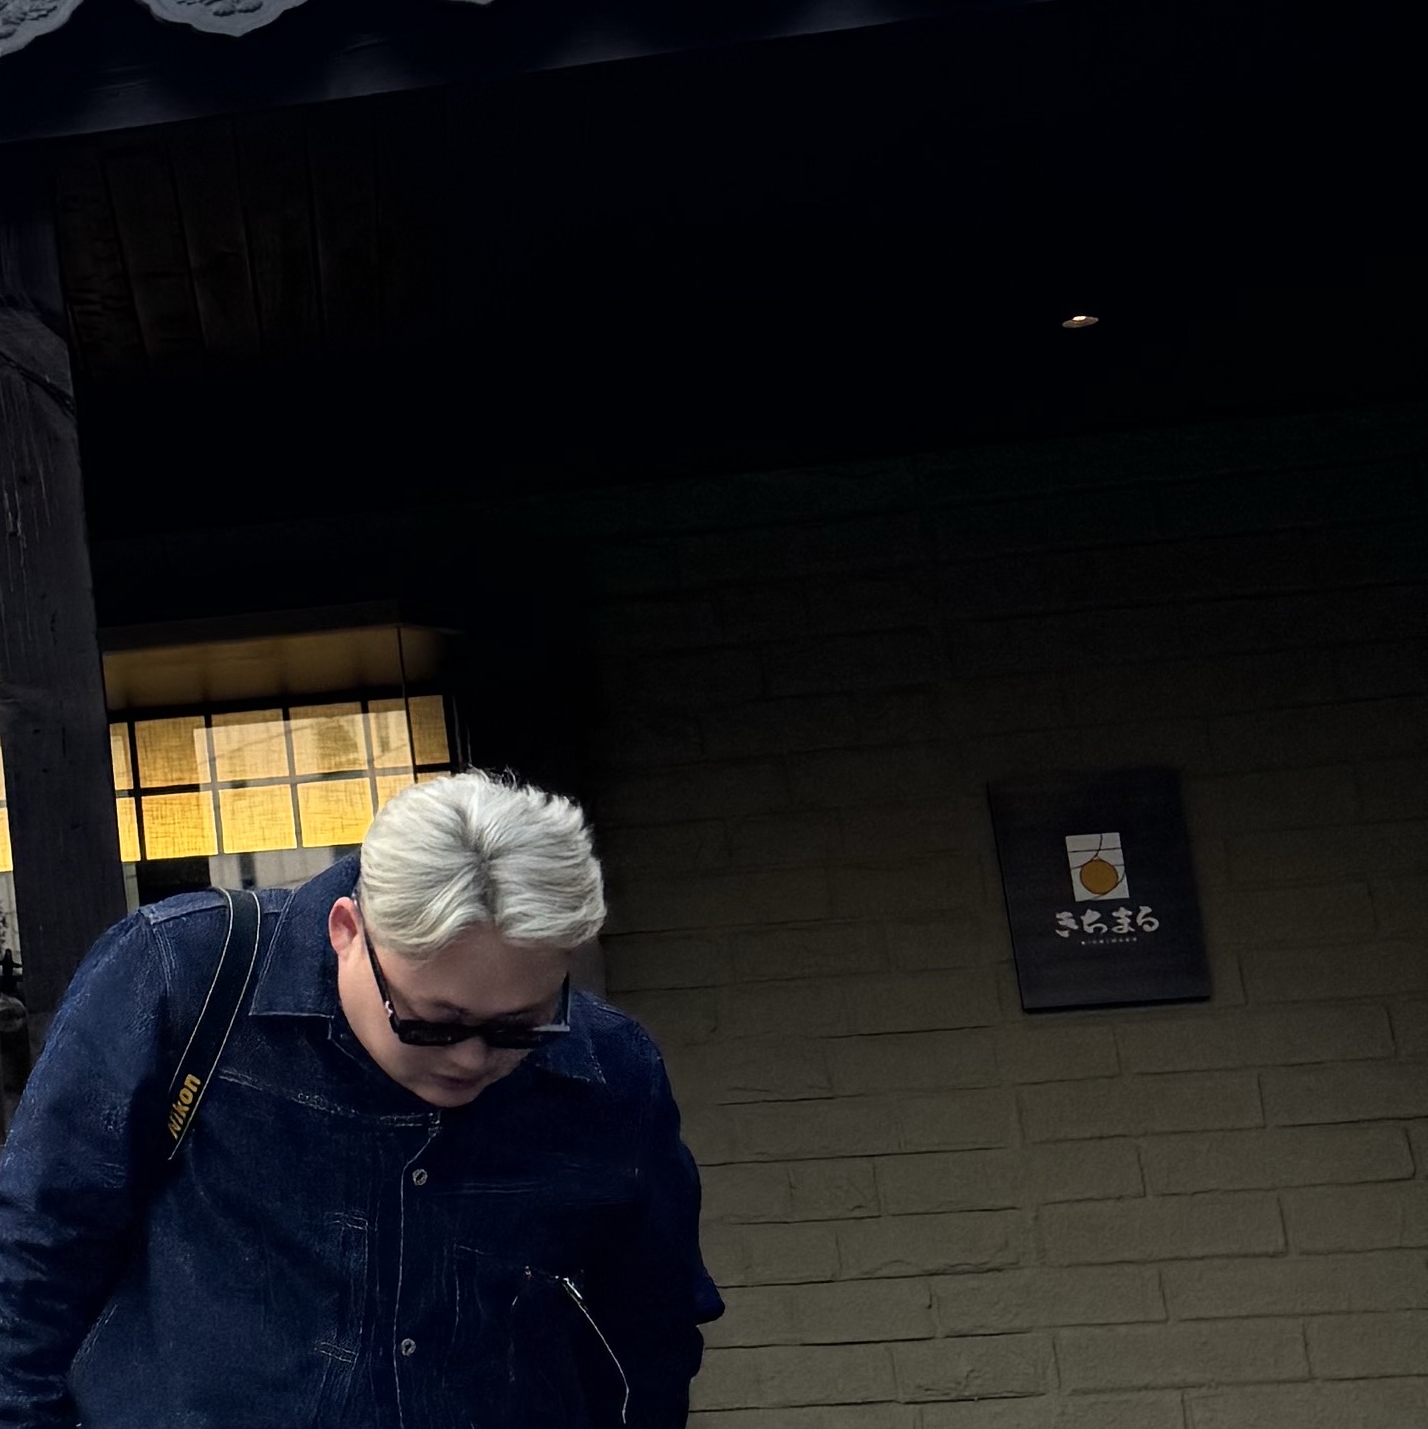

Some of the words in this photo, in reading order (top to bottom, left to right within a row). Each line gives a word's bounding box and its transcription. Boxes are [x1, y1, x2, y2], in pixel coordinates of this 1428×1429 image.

[1055, 905, 1159, 938] きちまる
[168, 1074, 201, 1140] Nikon
